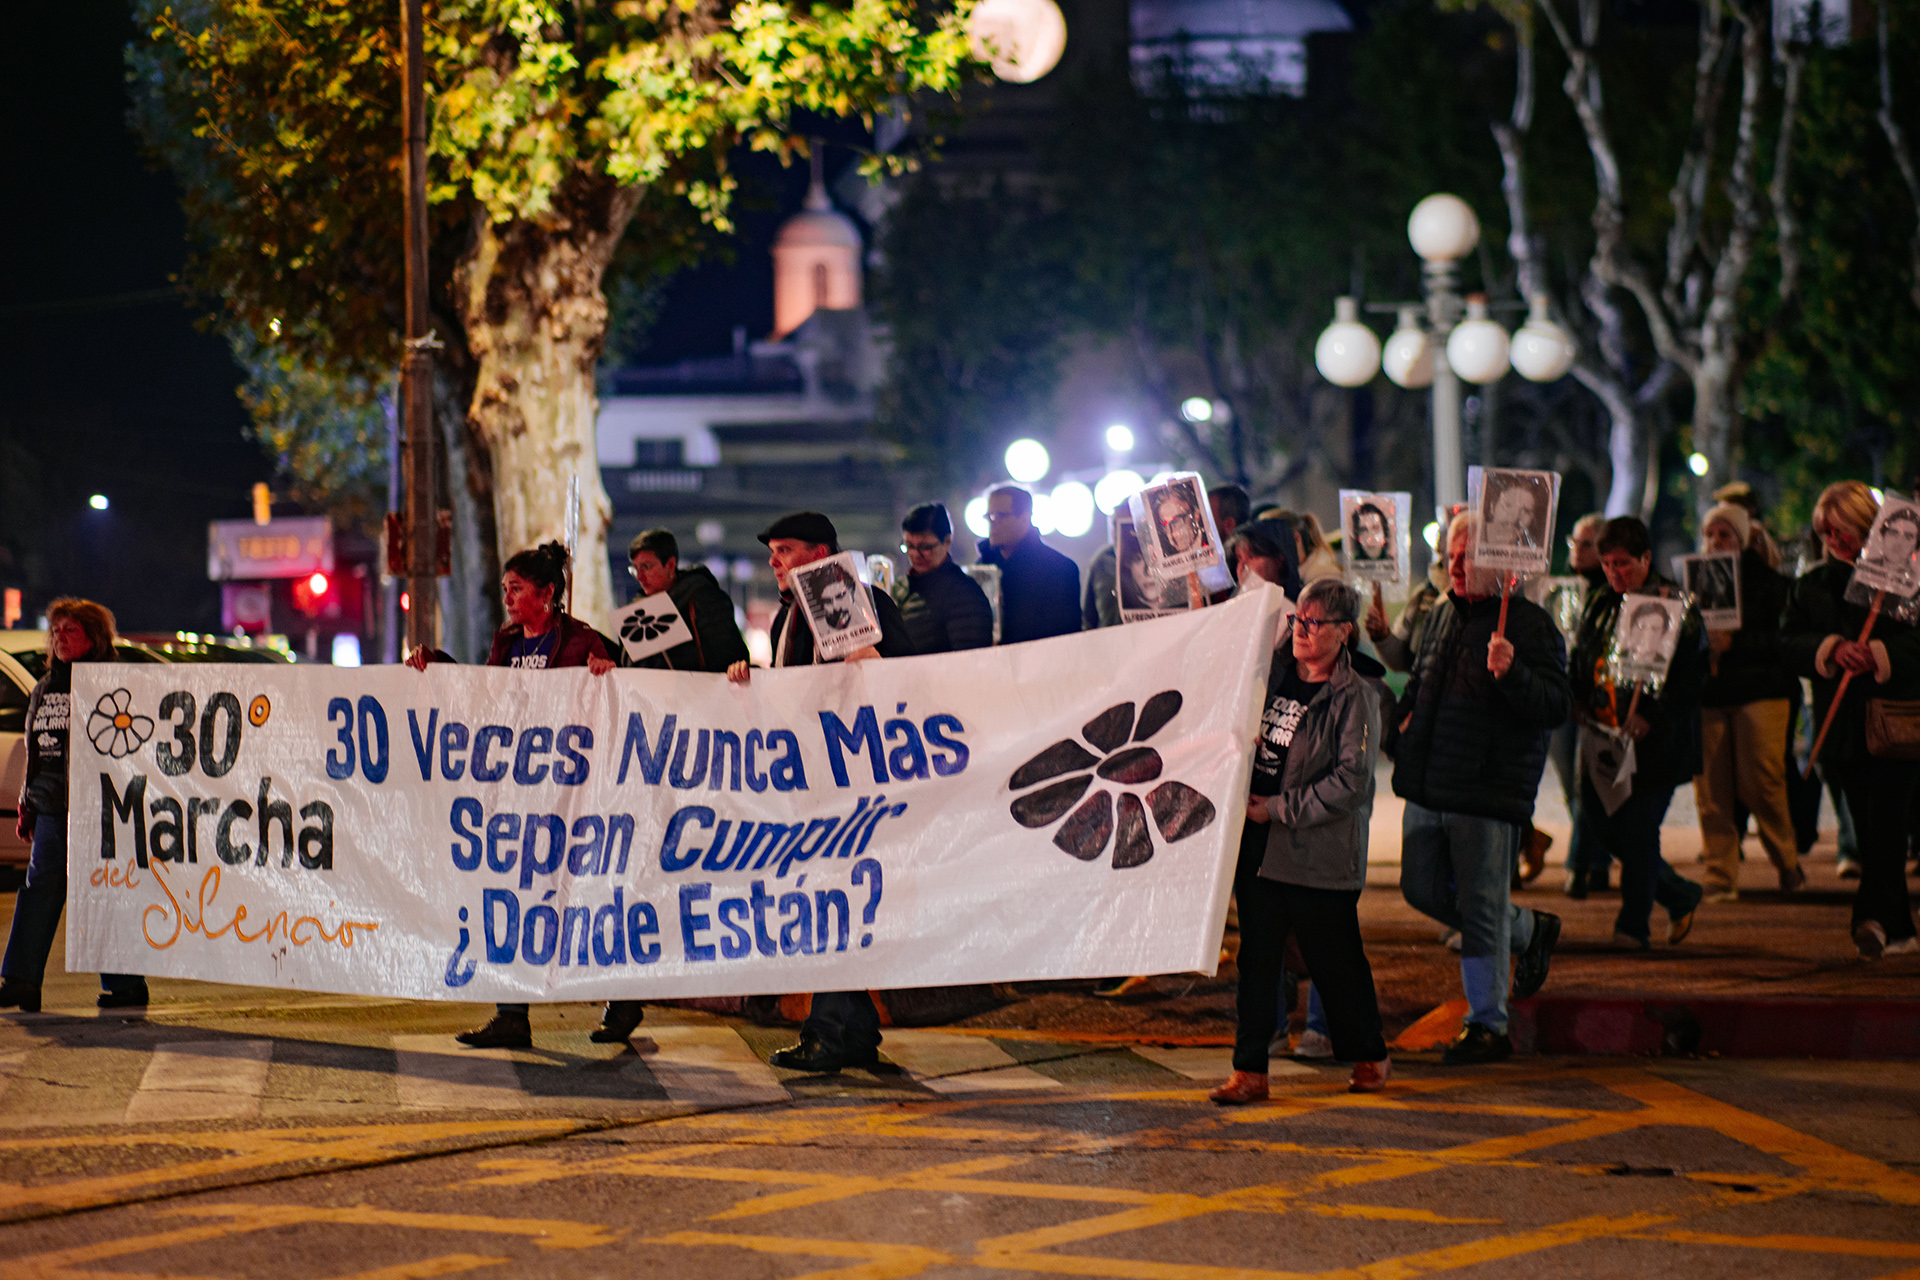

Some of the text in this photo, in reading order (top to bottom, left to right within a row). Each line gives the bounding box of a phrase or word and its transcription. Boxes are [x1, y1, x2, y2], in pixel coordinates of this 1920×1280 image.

[1162, 556, 1185, 569] MANUEL
[822, 634, 849, 648] HELIOS
[850, 625, 875, 638] SERRA
[156, 690, 271, 778] 30°
[326, 694, 970, 793] 30 Veces Nunca Más
[100, 772, 335, 870] Marcha
[450, 797, 635, 890] Sepan
[91, 856, 379, 950] del Silencio
[445, 857, 883, 988] ¿Dónde Están?
